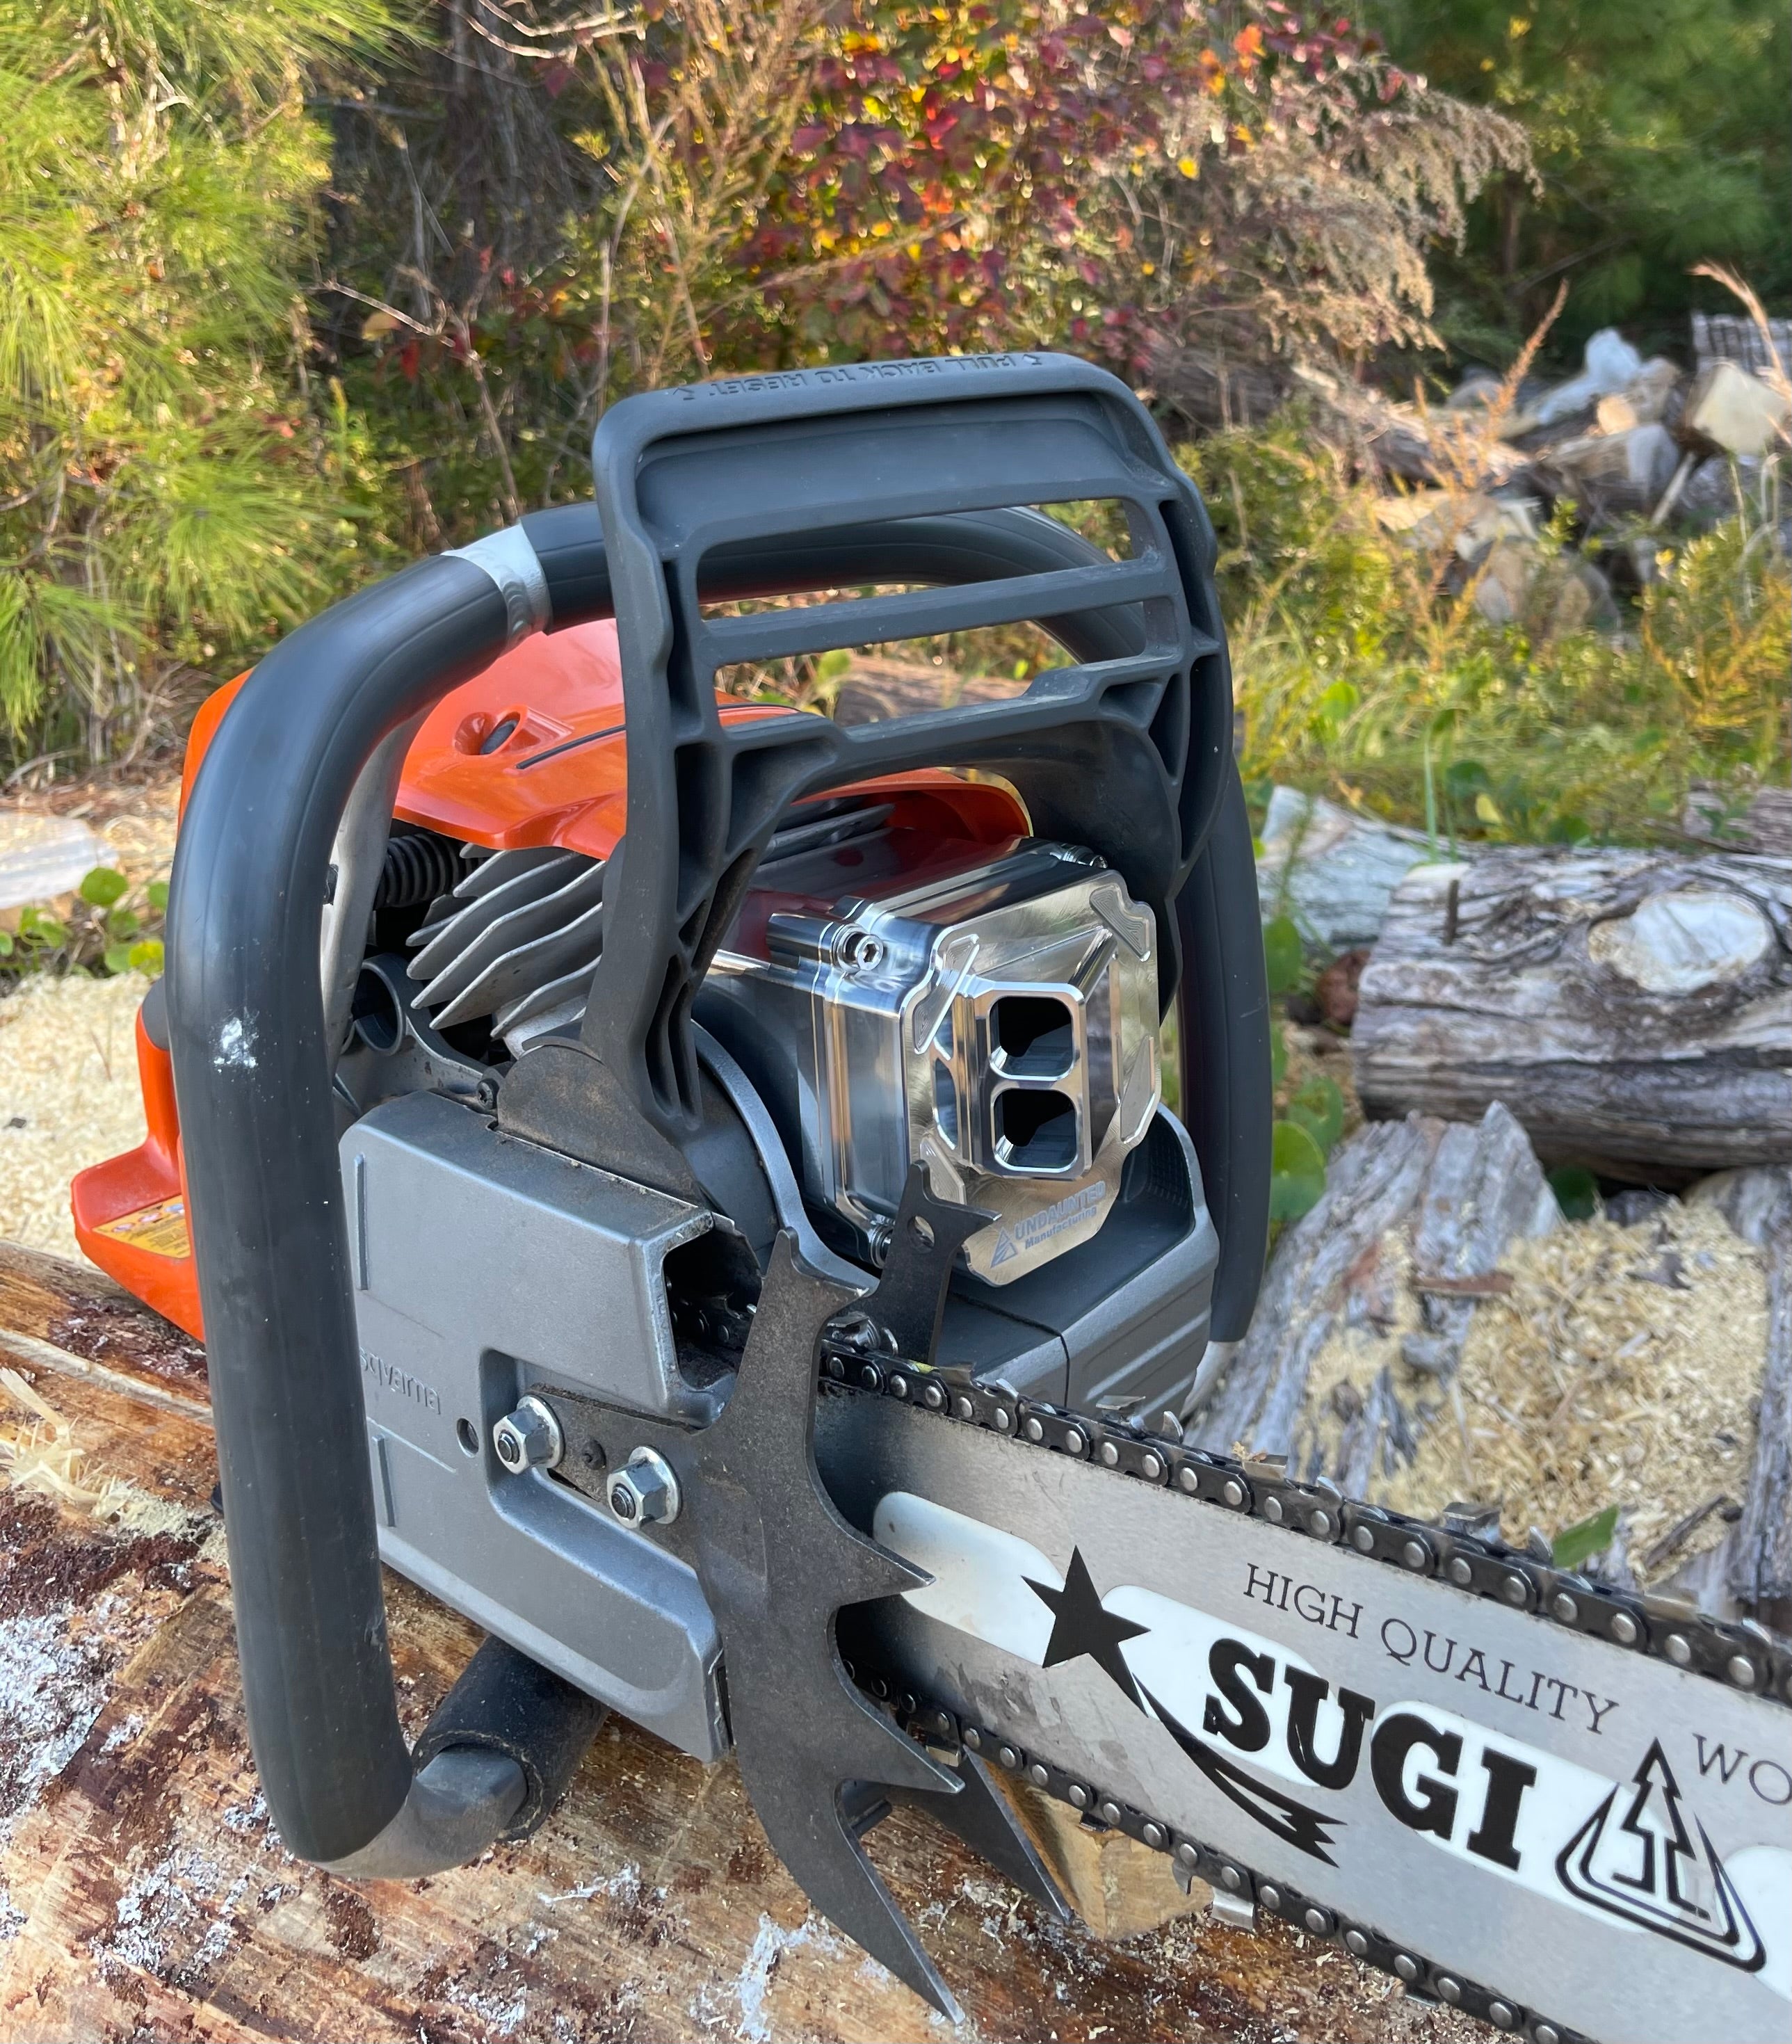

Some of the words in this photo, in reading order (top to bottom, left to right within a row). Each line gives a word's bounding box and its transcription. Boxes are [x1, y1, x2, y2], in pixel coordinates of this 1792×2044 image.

[814, 368, 856, 385] TO
[859, 360, 942, 379] BACK
[944, 354, 1017, 371] PULL
[709, 372, 807, 396] RESET
[1014, 1180, 1106, 1241] UNDAUNTED
[1025, 1205, 1098, 1250] Manufacturing
[1243, 1563, 1364, 1640] HIGH
[1380, 1617, 1620, 1735] QUALITY
[1692, 1732, 1792, 1806] WO
[1202, 1637, 1538, 1872] SUGI
